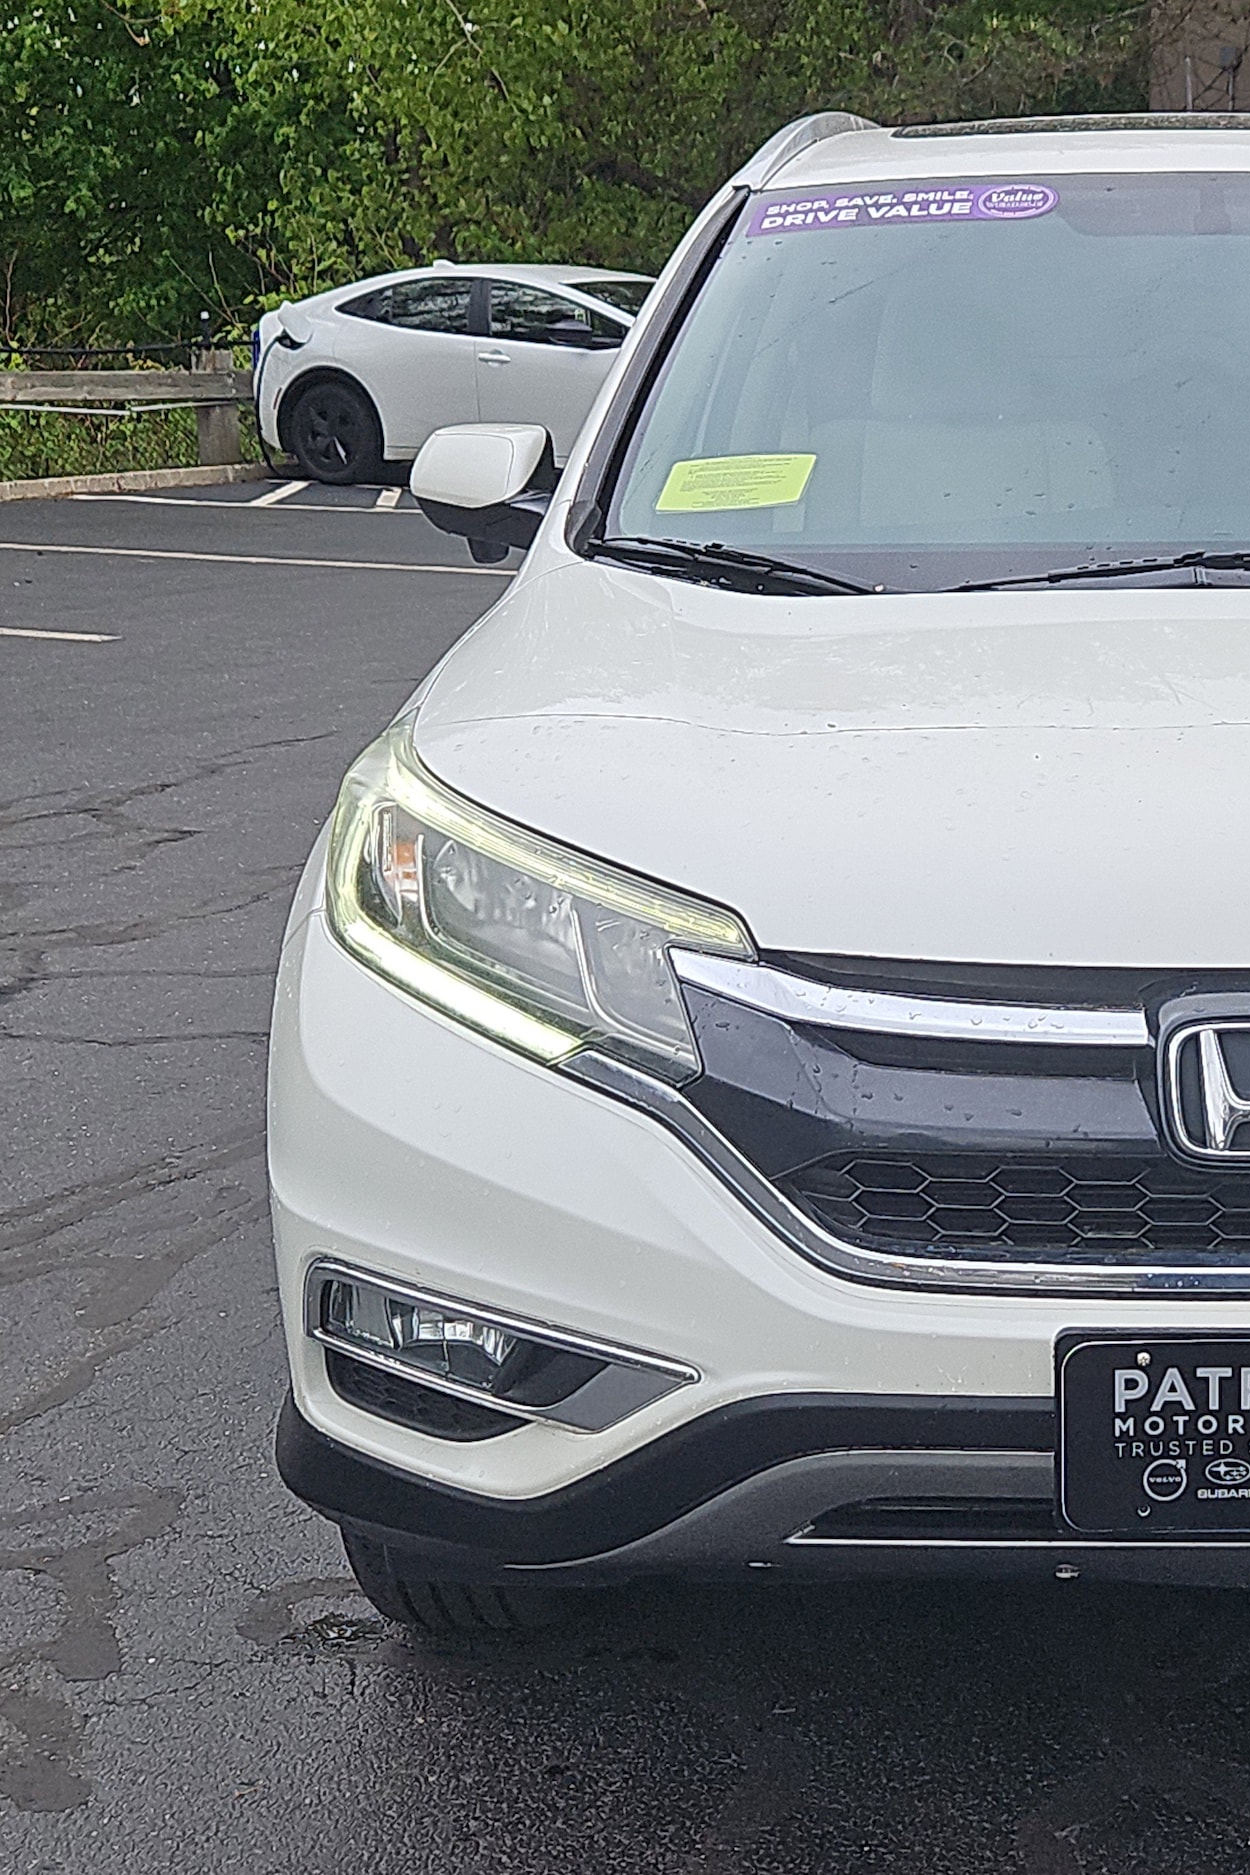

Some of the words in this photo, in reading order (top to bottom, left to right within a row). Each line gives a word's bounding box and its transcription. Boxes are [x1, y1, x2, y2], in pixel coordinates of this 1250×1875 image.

[834, 193, 898, 207] SAVE.
[991, 191, 1044, 203] Value
[761, 208, 859, 229] DRIVE
[867, 202, 973, 219] VALUE
[1114, 1414, 1246, 1437] MOTOR
[1115, 1439, 1233, 1458] TRUSTED
